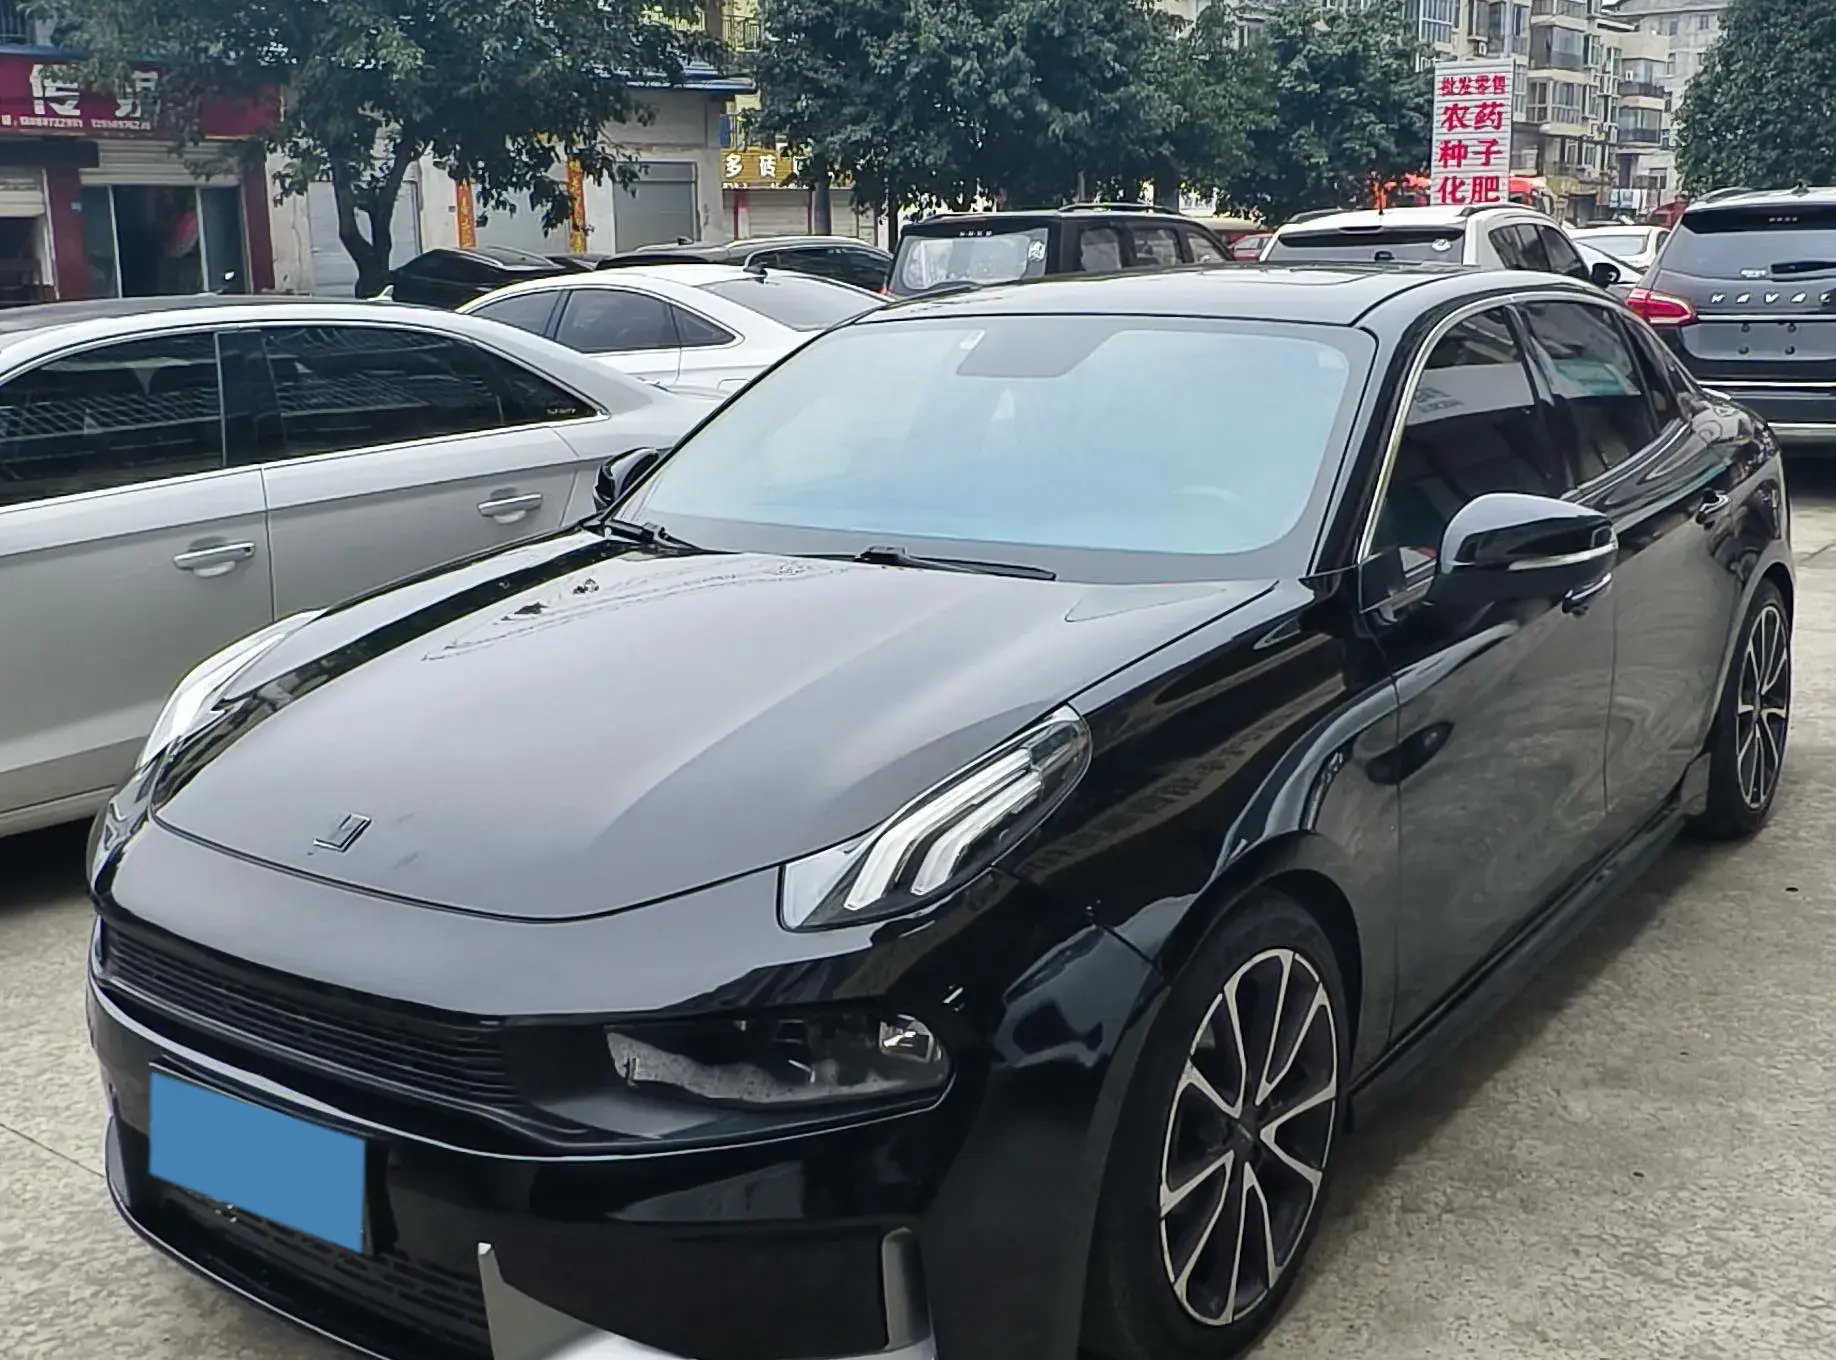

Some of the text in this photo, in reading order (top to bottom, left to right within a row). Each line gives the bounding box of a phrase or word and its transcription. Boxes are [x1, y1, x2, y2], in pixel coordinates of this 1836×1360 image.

[1439, 74, 1507, 97] 批发零售
[1440, 101, 1505, 132] 农药
[1438, 138, 1504, 168] 种子
[1436, 175, 1501, 205] 化肥
